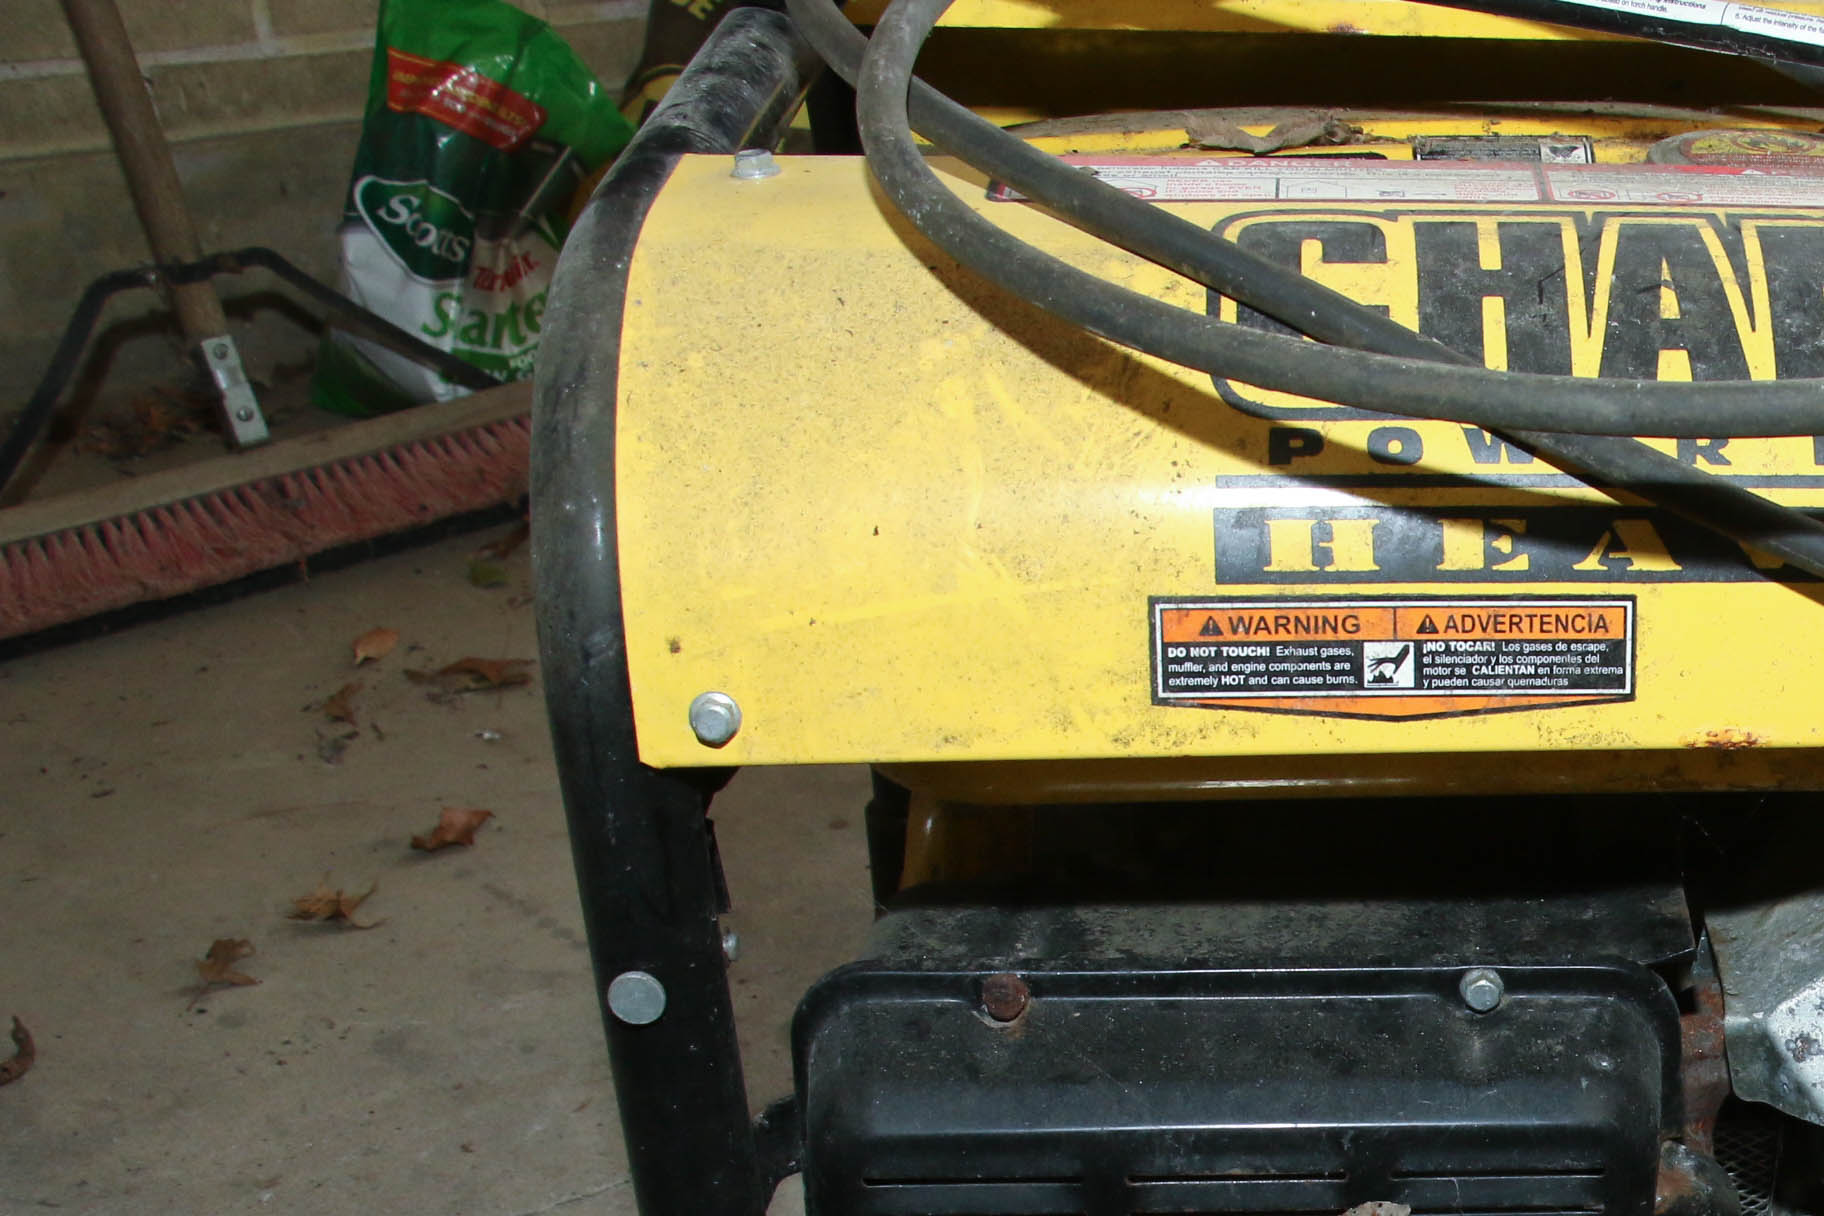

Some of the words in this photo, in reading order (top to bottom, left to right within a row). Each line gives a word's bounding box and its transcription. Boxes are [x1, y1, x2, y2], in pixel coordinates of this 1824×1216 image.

[1268, 426, 1733, 467] POWR
[1229, 614, 1361, 636] WARNING
[1444, 613, 1609, 635] ADVERTENCIA
[1167, 646, 1187, 658] DO
[1190, 646, 1217, 658] NOT
[1221, 646, 1270, 657] TOUCH!
[1276, 645, 1318, 657] Exhaust
[1321, 646, 1355, 659] gases,
[1422, 642, 1446, 654] ¡NO
[1448, 641, 1496, 652] TOCAR!
[1502, 641, 1520, 652] Los
[1523, 642, 1553, 654] gases
[1555, 641, 1568, 652] de
[1570, 642, 1609, 654] escape,
[1423, 654, 1432, 664] el
[1434, 653, 1487, 664] silenciador
[1490, 655, 1497, 666] y
[1499, 653, 1514, 664] los
[1516, 653, 1582, 666] componentes
[1585, 652, 1600, 663] del
[1168, 662, 1207, 675] muffler,
[1208, 661, 1227, 672] and
[1231, 661, 1266, 674] engine
[1269, 661, 1331, 674] components
[1334, 661, 1351, 671] are
[1423, 665, 1451, 675] motor
[1454, 667, 1467, 675] se
[1472, 664, 1536, 675] CALIENTAN
[1537, 666, 1551, 675] en
[1553, 664, 1582, 675] forma
[1583, 665, 1623, 675] extrema
[1168, 675, 1219, 688] extremely
[1221, 674, 1245, 686] HOT
[1248, 674, 1268, 685] and
[1271, 675, 1290, 685] can
[1292, 675, 1324, 685] cause
[1326, 673, 1358, 685] burns.
[1423, 678, 1429, 688] y
[1431, 677, 1469, 689] pueden
[1471, 677, 1504, 687] causar
[1507, 676, 1569, 688] quemaduras
